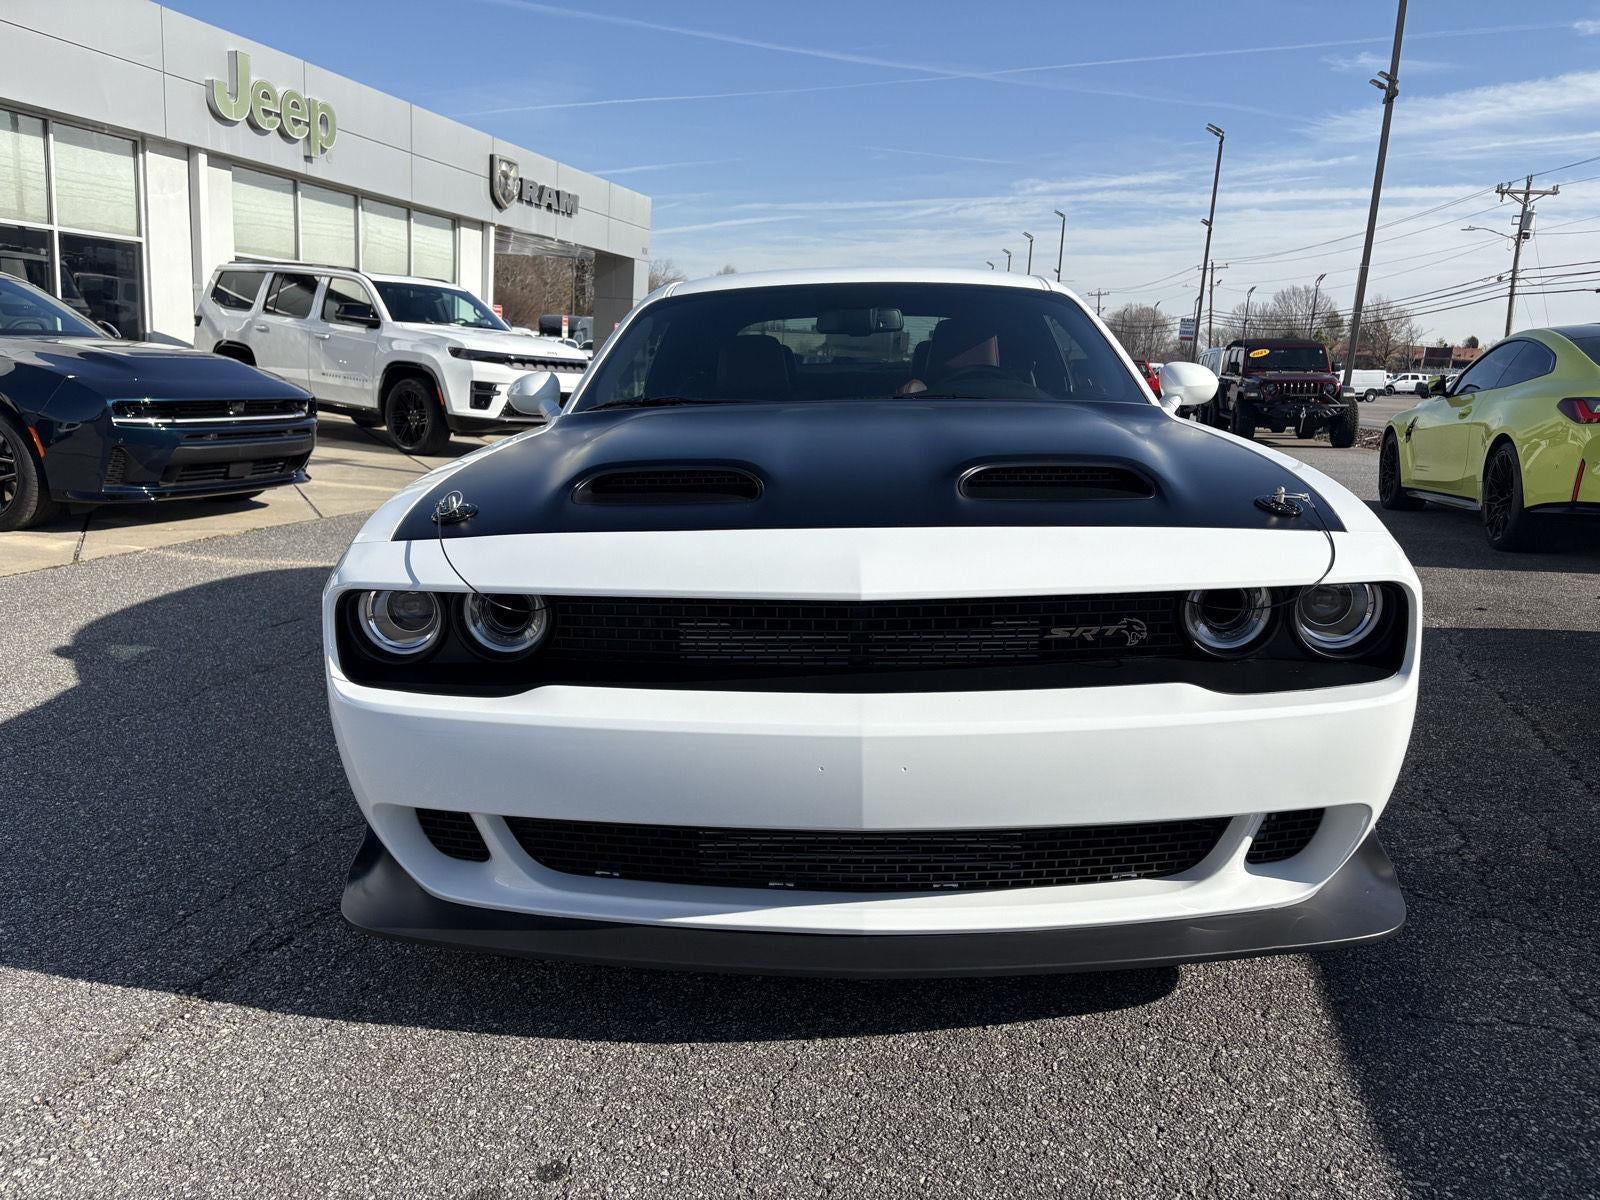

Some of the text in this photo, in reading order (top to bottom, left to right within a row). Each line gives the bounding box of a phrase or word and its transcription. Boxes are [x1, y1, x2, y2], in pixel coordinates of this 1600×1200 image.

[206, 50, 337, 159] Jeep
[519, 177, 580, 216] RAM
[1043, 625, 1127, 641] SRT
